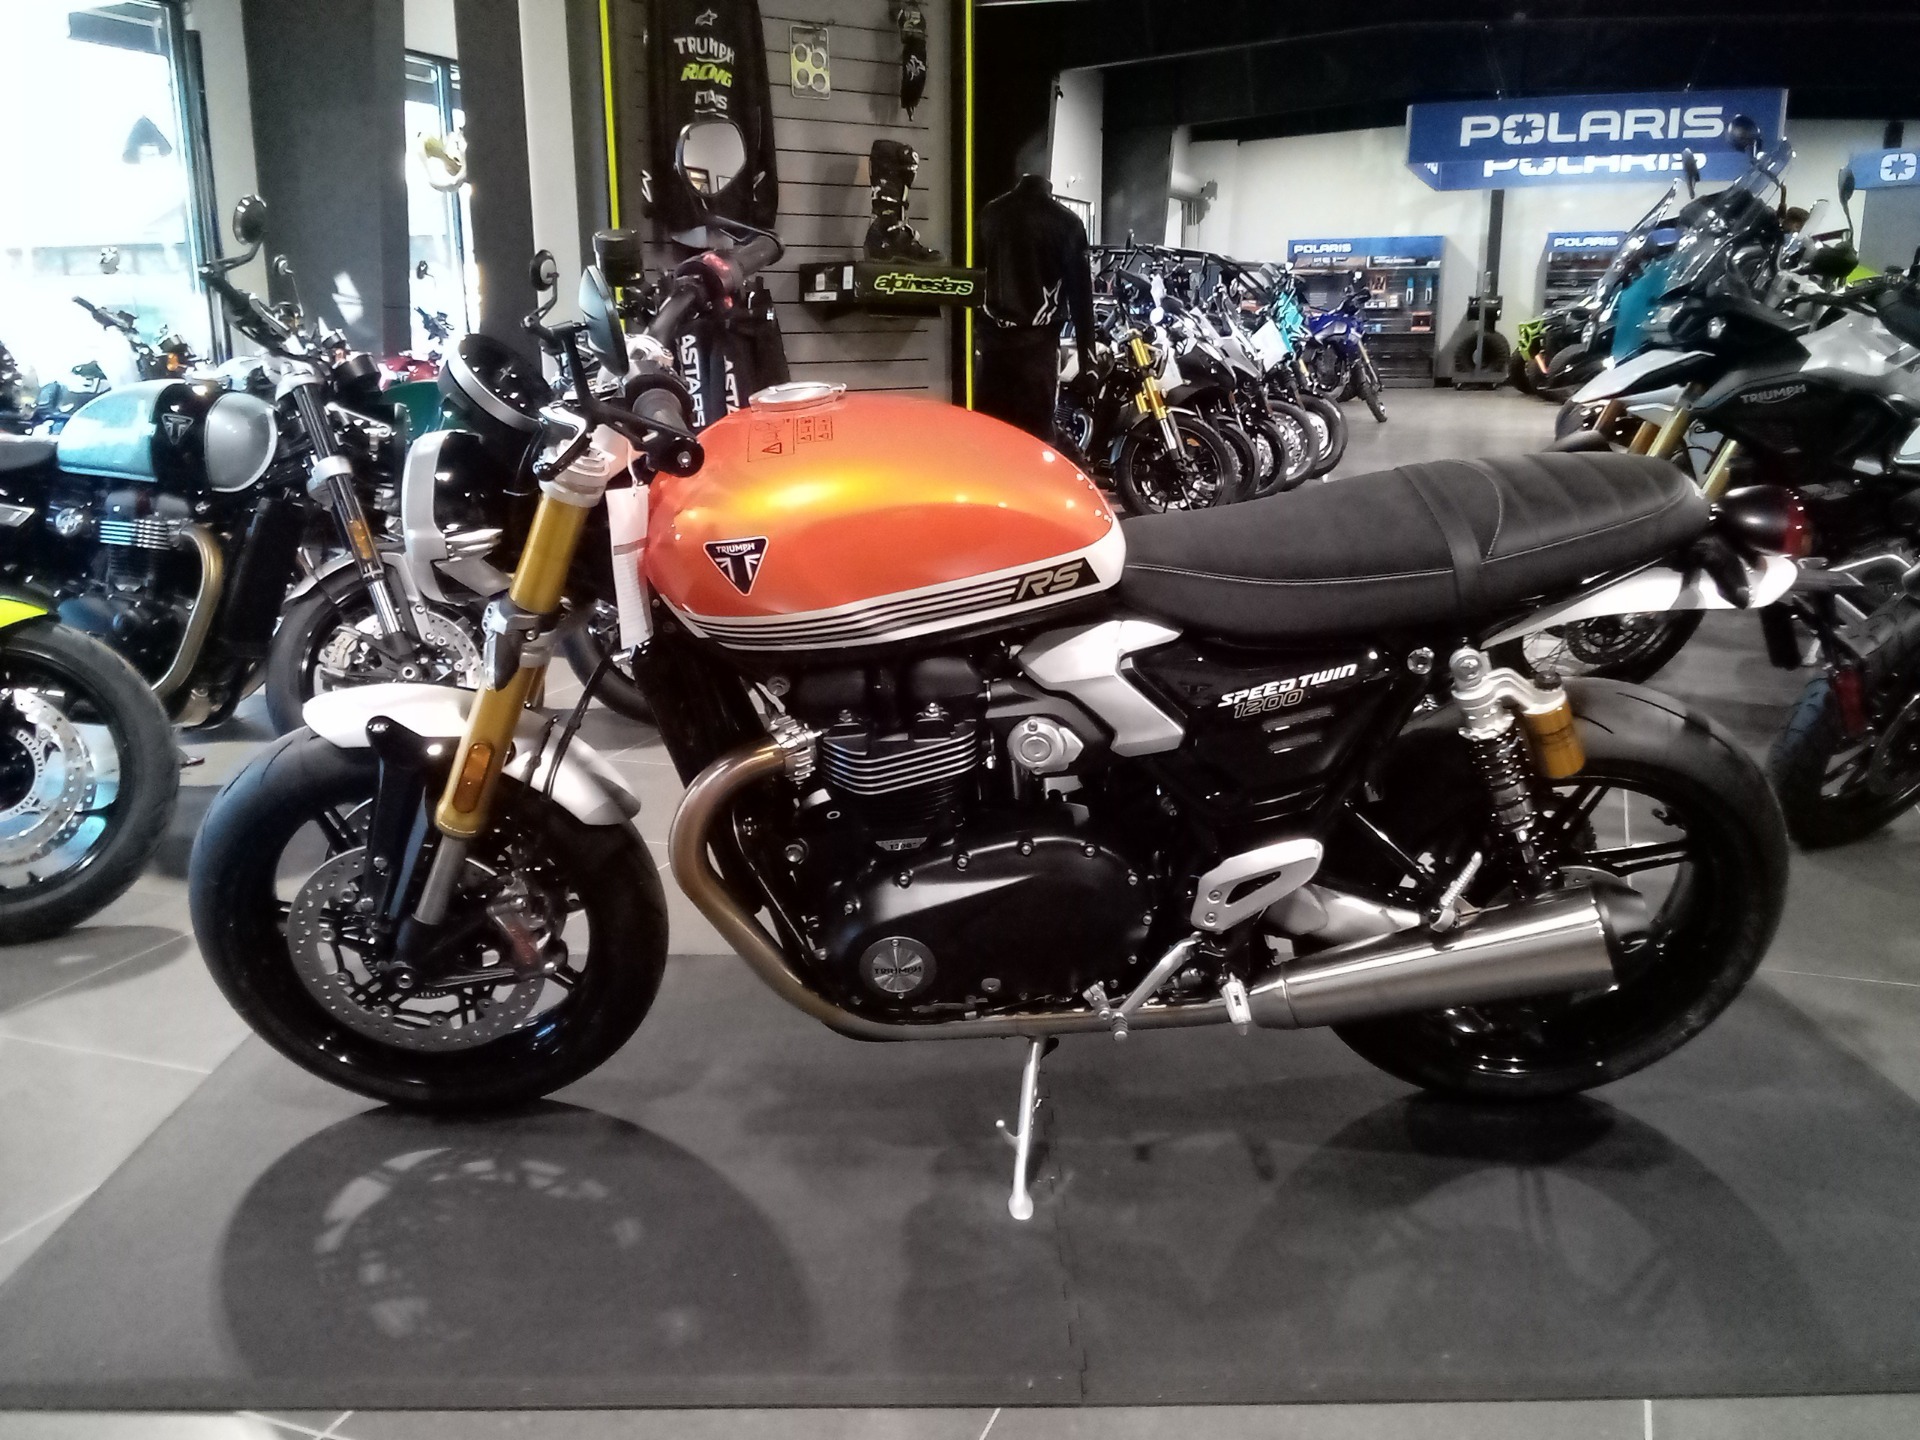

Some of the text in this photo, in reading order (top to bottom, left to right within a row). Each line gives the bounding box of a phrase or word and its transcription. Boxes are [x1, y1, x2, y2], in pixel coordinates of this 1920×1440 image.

[1459, 105, 1725, 148] POLARIS
[1293, 243, 1352, 254] POLARIS
[1553, 236, 1619, 248] POLARIS
[874, 272, 974, 296] alpinestars
[1740, 384, 1807, 404] TRIUMPH
[715, 542, 756, 555] TRIUMPH
[1015, 561, 1084, 601] RS
[1217, 663, 1358, 708] SPEED TWIN
[1233, 688, 1305, 719] 1200
